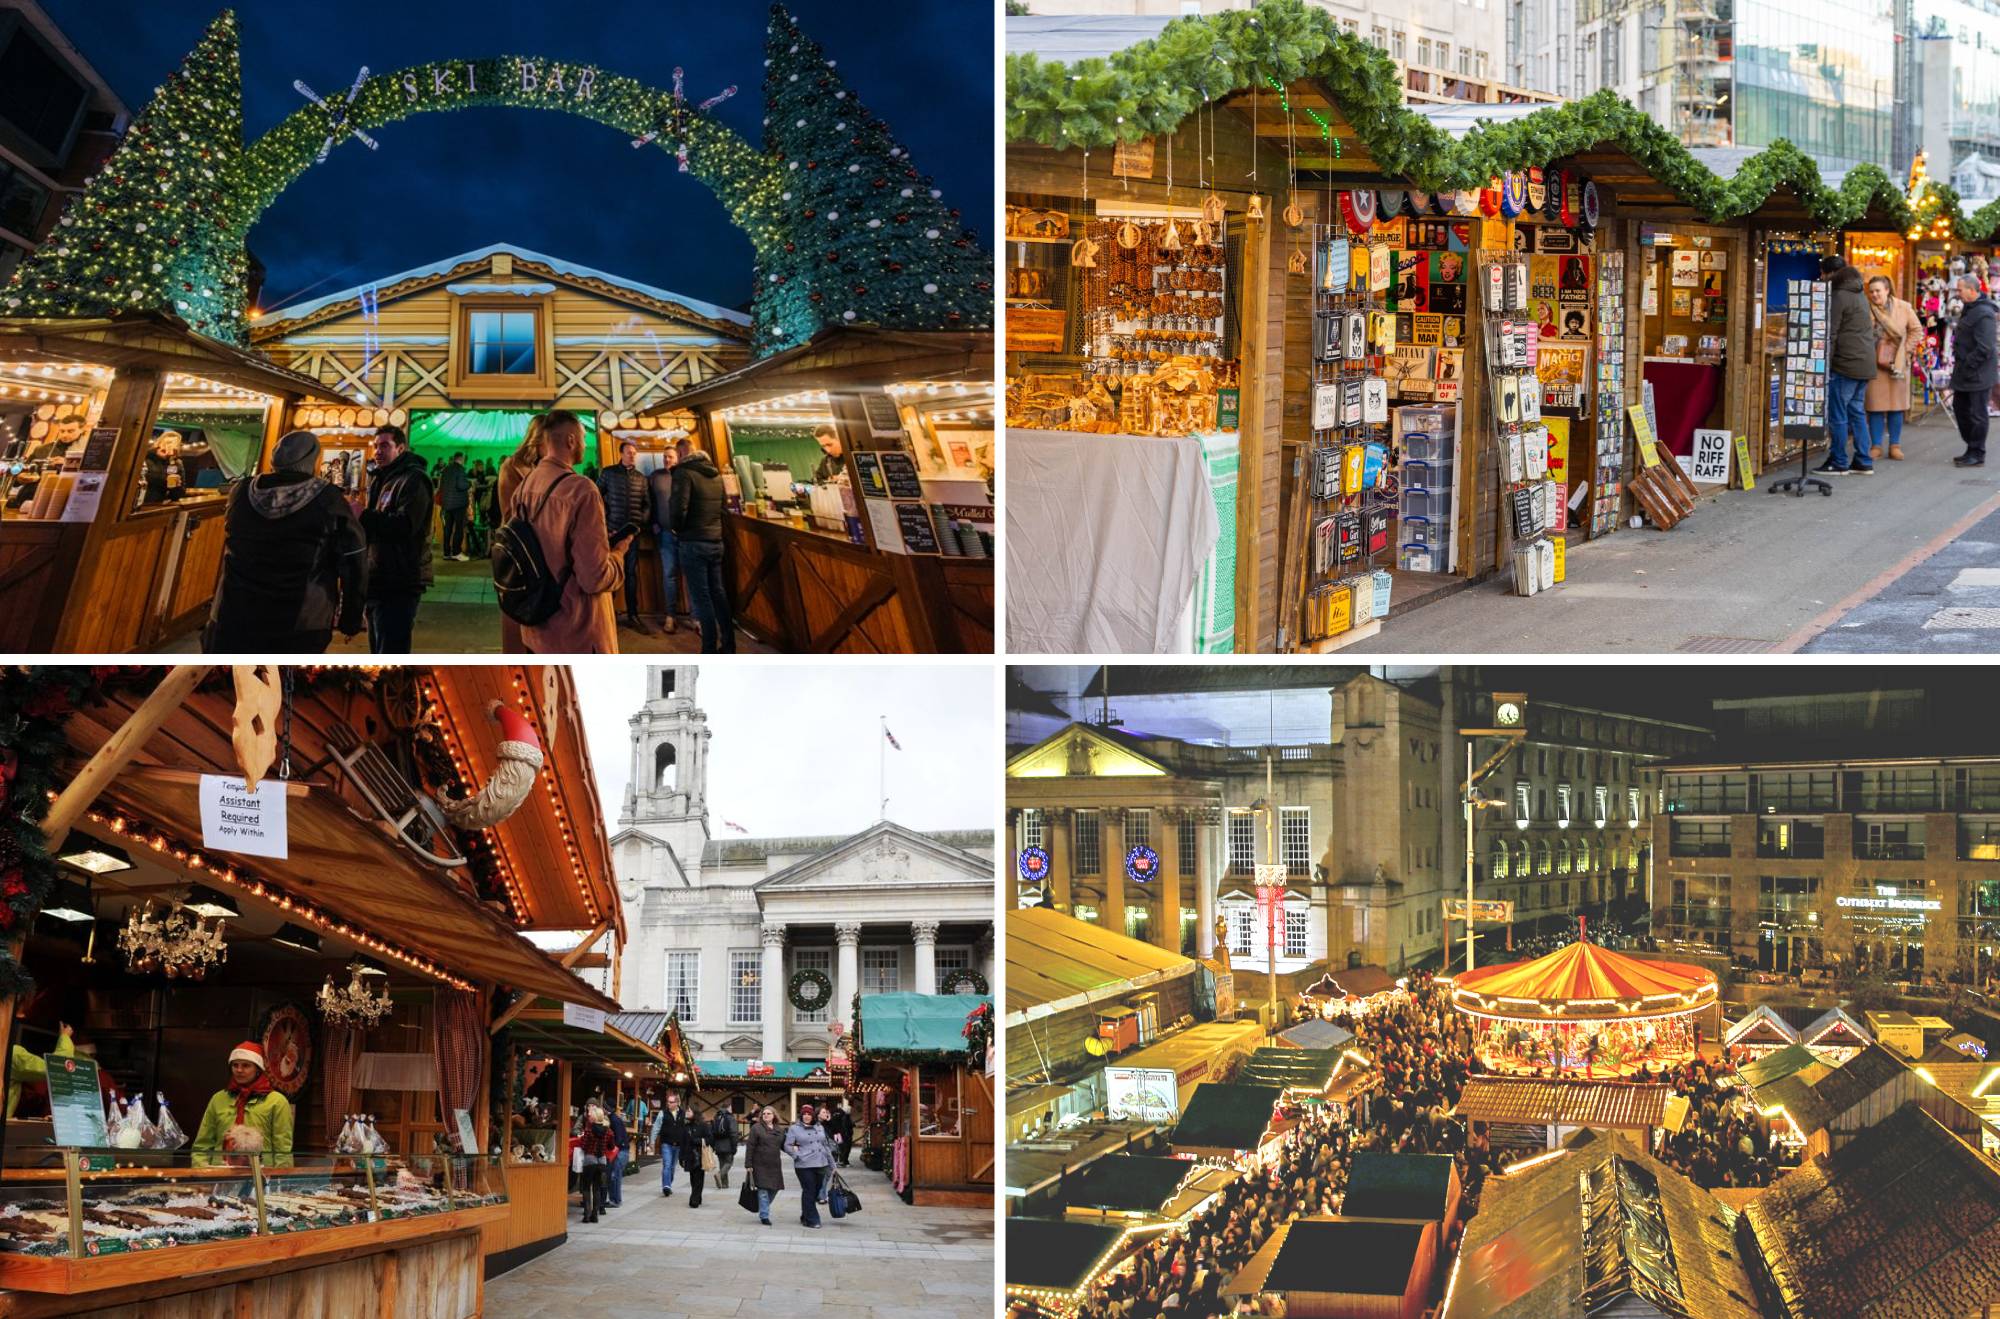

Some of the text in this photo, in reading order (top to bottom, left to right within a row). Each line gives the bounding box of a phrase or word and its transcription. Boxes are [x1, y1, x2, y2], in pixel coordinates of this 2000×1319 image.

[402, 62, 596, 102] SKI BAR
[1532, 285, 1555, 298] BEER
[1418, 334, 1438, 343] MAN
[1554, 394, 1573, 405] LOVE
[1701, 436, 1725, 450] NO
[1698, 451, 1725, 463] RIFF
[1695, 464, 1726, 477] RAFF
[223, 781, 259, 794] Tempory
[219, 795, 261, 808] Assistant
[221, 810, 260, 823] Required
[219, 825, 264, 837] Apply Within
[1876, 885, 1897, 896] THE
